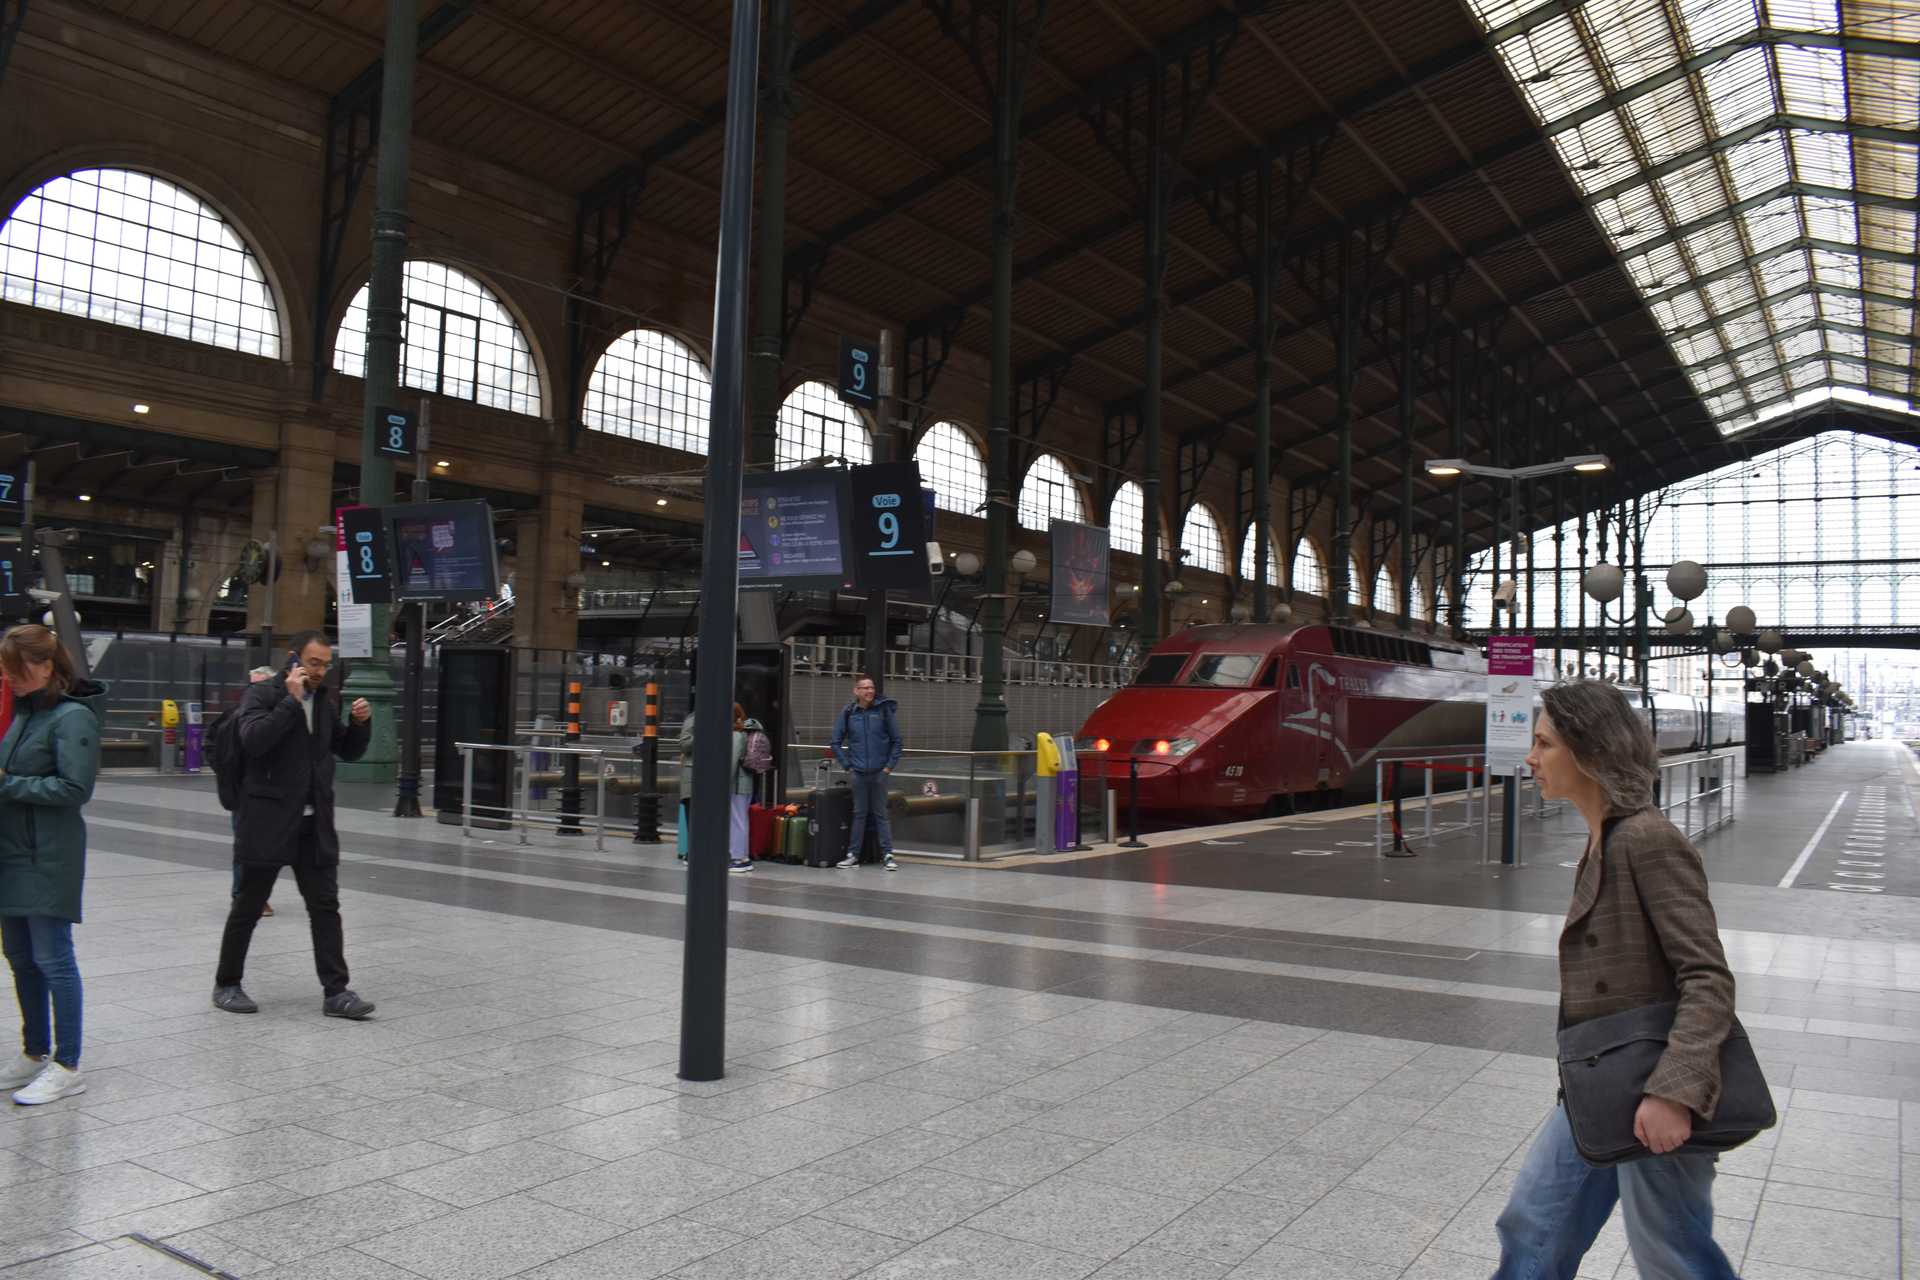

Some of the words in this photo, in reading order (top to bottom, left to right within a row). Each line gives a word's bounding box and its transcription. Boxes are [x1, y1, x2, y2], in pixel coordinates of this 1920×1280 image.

[853, 363, 865, 391] 9
[390, 426, 403, 448] 8
[0, 482, 12, 499] 7
[874, 495, 897, 506] Voie
[878, 512, 899, 549] 9
[360, 545, 374, 573] 8
